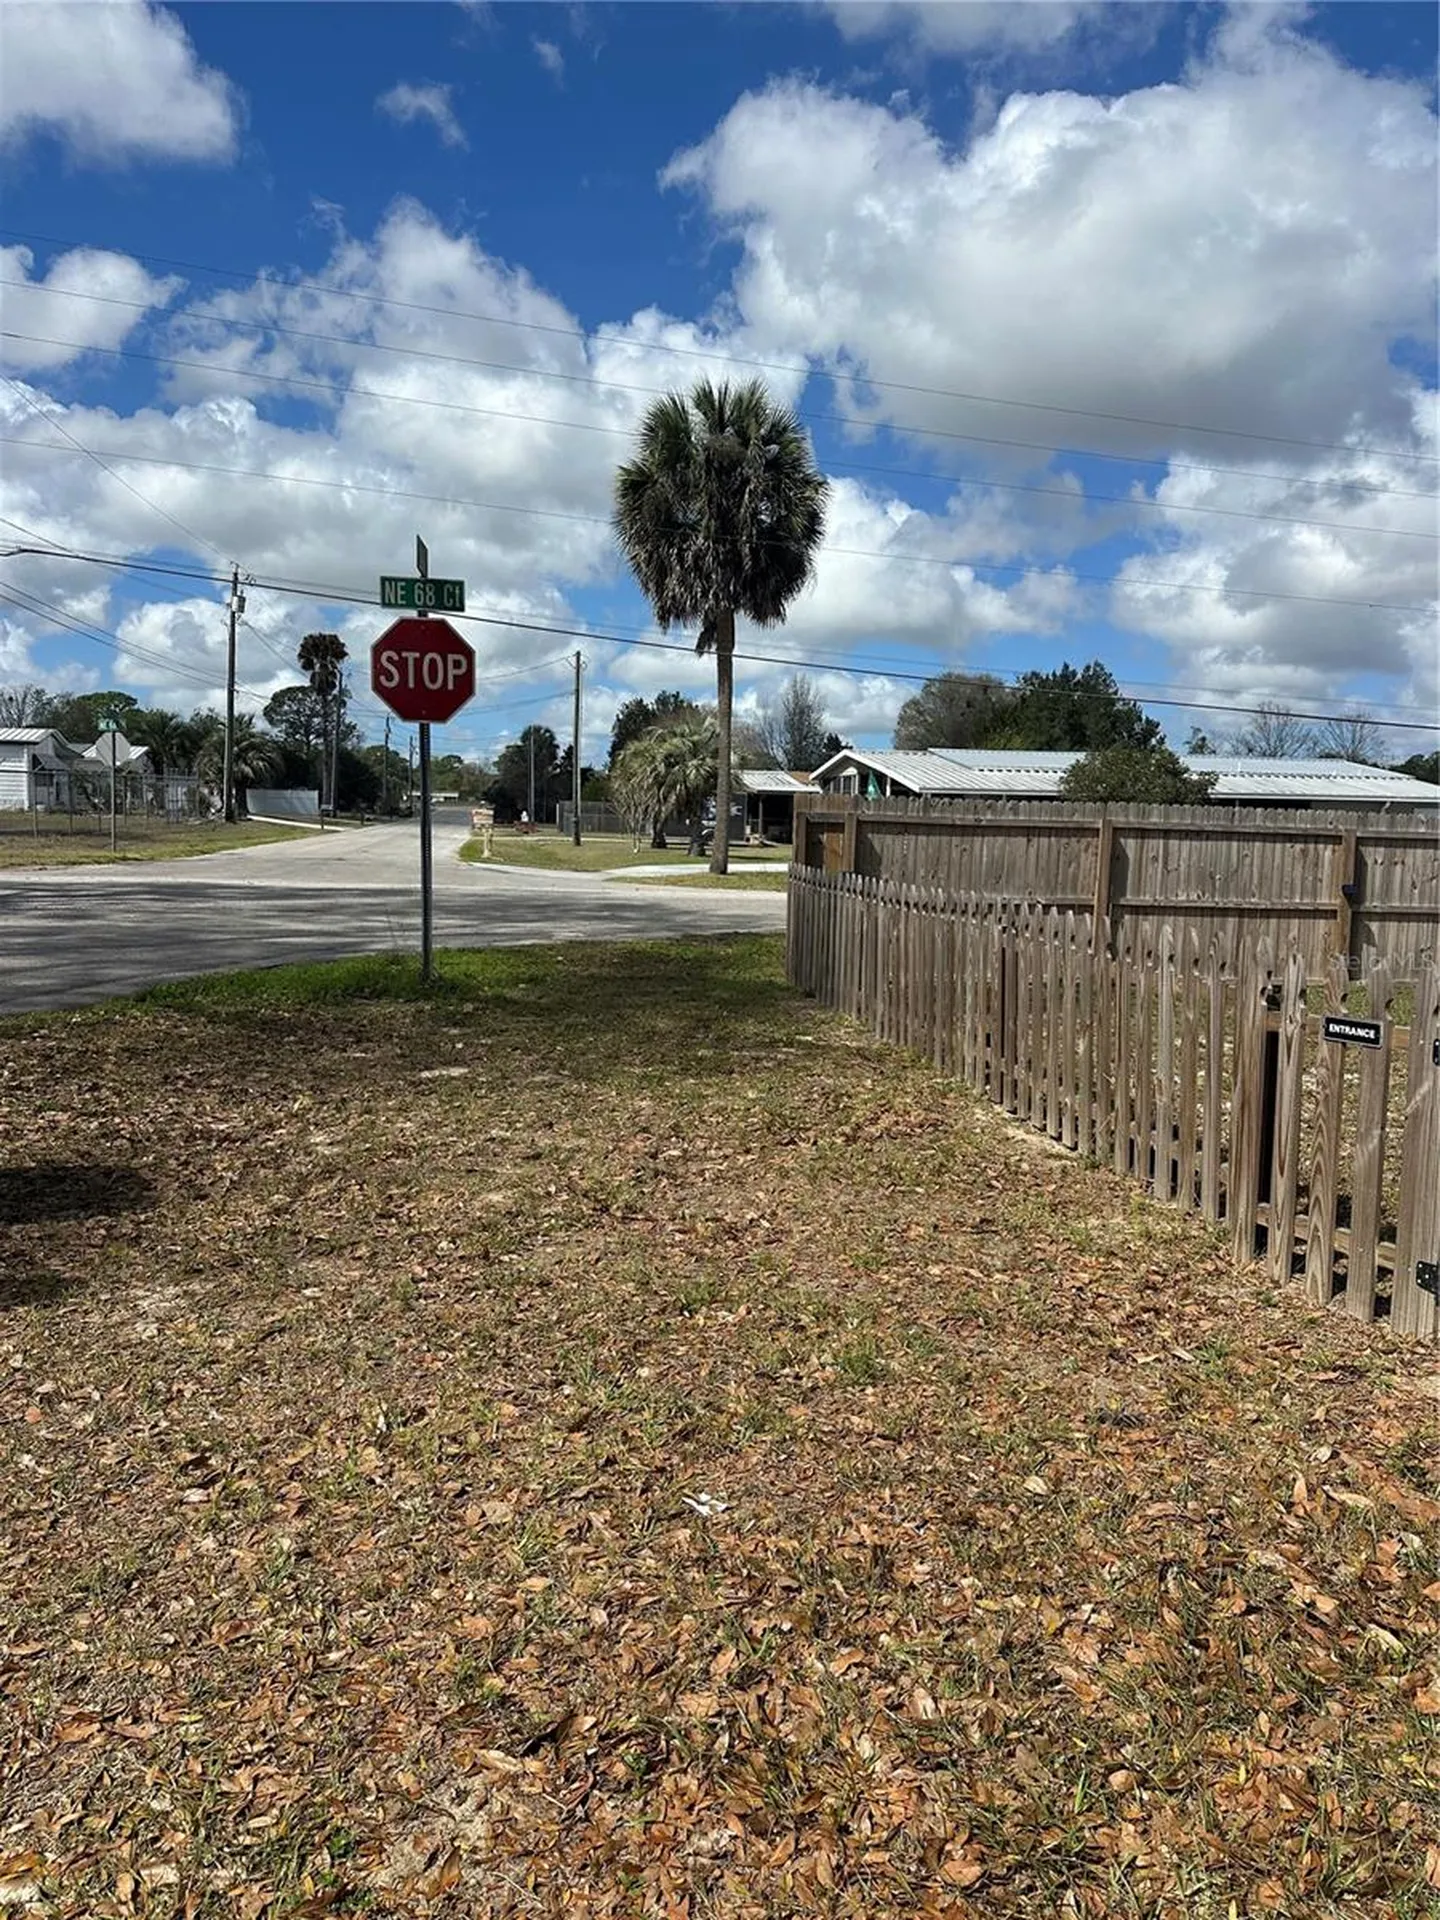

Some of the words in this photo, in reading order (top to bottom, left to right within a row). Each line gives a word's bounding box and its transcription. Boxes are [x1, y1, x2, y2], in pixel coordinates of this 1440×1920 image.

[384, 580, 406, 605] NE
[414, 582, 436, 607] 68
[443, 584, 461, 608] Ct
[379, 650, 468, 690] STOP
[1328, 1023, 1376, 1039] ENTRANCE
